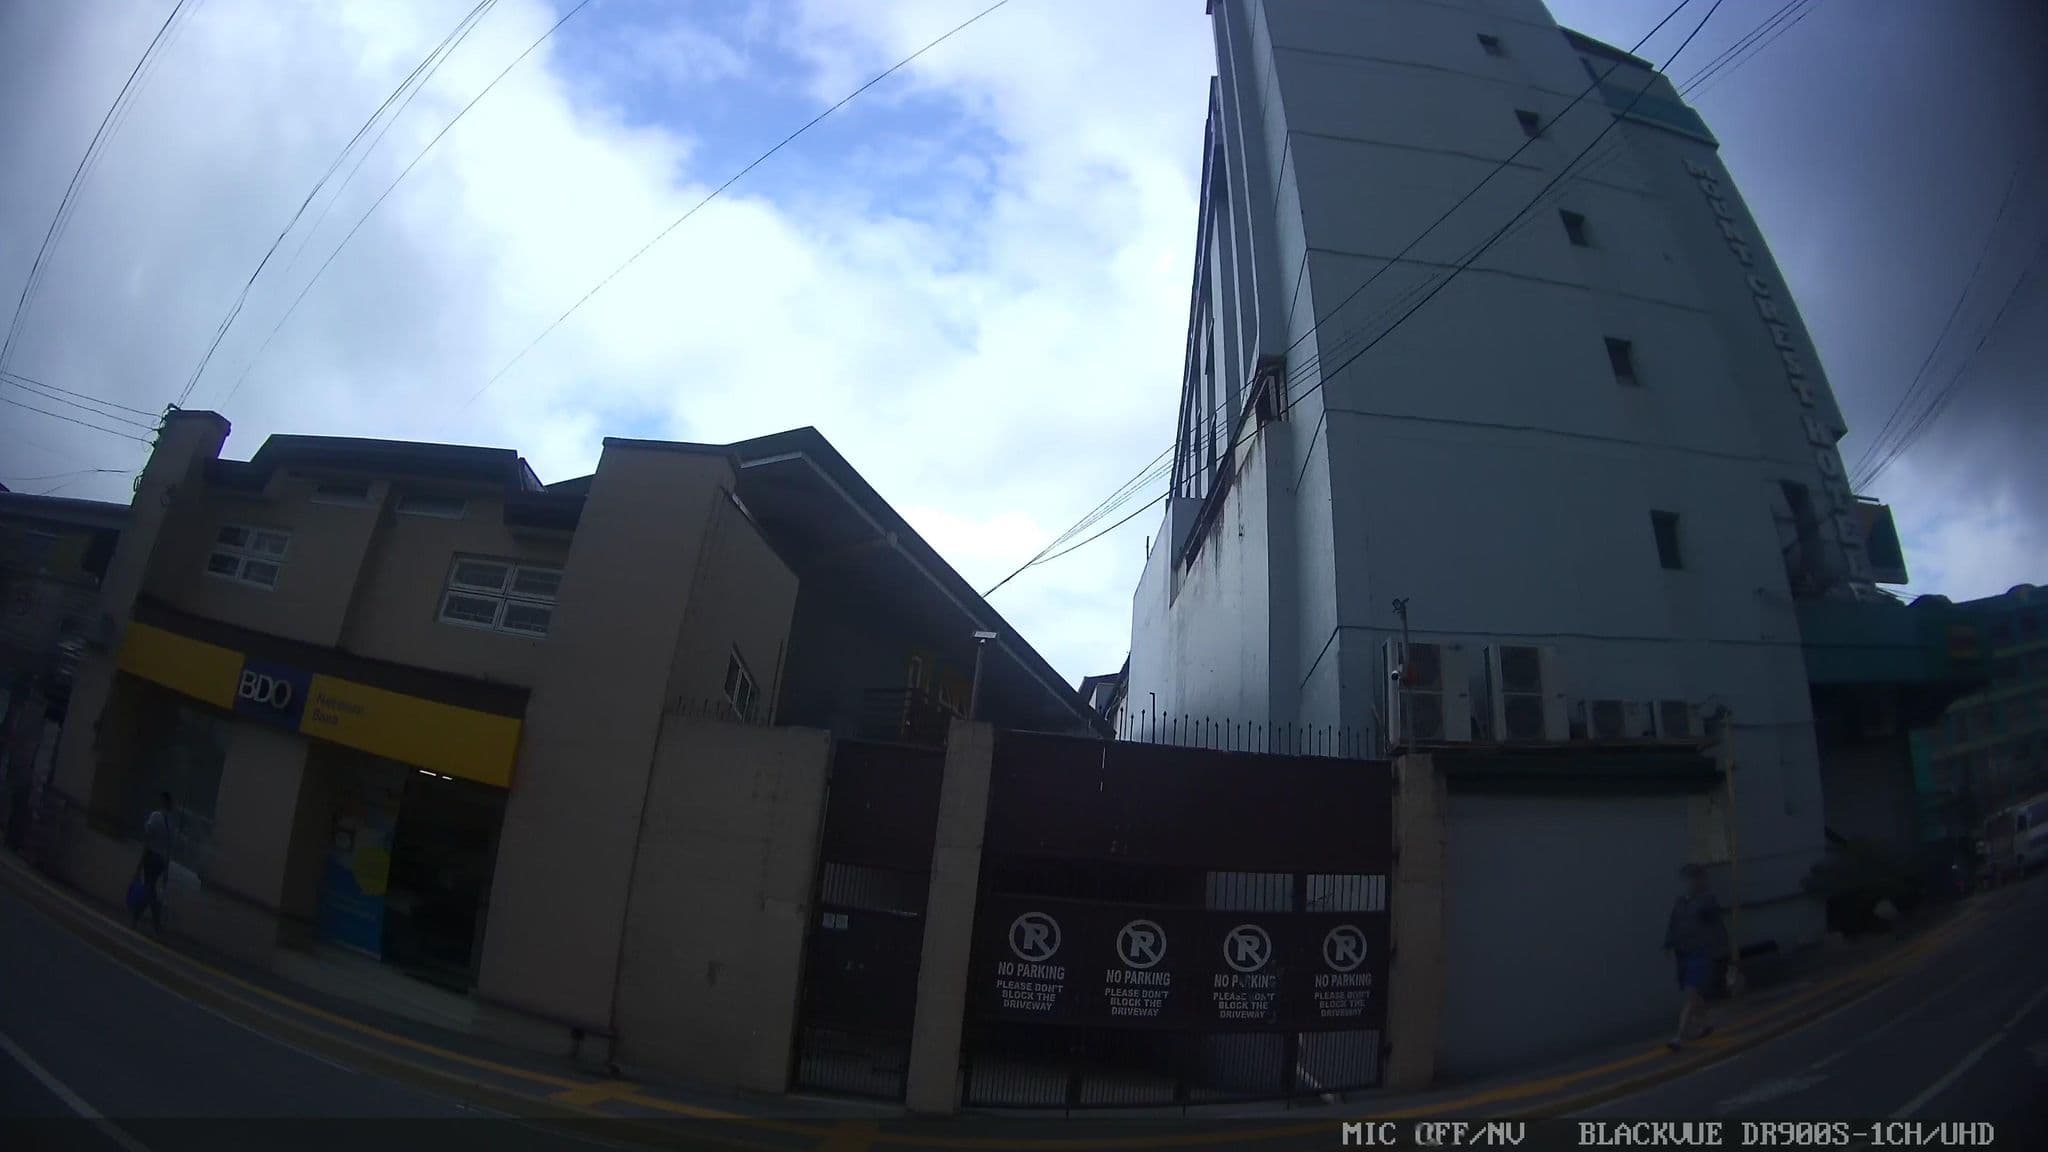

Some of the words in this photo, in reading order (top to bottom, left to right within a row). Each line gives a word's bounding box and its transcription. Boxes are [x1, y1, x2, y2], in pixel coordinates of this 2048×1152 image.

[1800, 415, 1874, 582] HOTEL
[239, 670, 292, 708] BDO
[998, 961, 1014, 975] NO
[1017, 963, 1065, 980] PARKING
[1106, 969, 1121, 983] NO
[1124, 970, 1171, 986] PARKING
[1214, 974, 1230, 988] NO
[1232, 974, 1276, 988] PKING
[1315, 974, 1329, 988] NO
[1331, 973, 1372, 987] PARKING
[996, 980, 1033, 992] PLEASE
[1035, 983, 1064, 993] DON'T
[1002, 990, 1034, 1001] BLOCK
[1037, 992, 1056, 1002] THE
[1104, 987, 1139, 998] PLEASE
[1141, 989, 1169, 999] DON'T
[1251, 992, 1275, 1001] ON'T
[1314, 992, 1345, 1000] PLEASE
[1003, 999, 1053, 1011] DRIVEWAY
[1110, 997, 1141, 1007] BLOCK
[1144, 998, 1162, 1008] THE
[1218, 1001, 1249, 1010] BLOCK
[1251, 1001, 1268, 1010] THE
[1111, 1006, 1160, 1017] DRIVEWAY
[1219, 1009, 1266, 1018] DRIVEWAY
